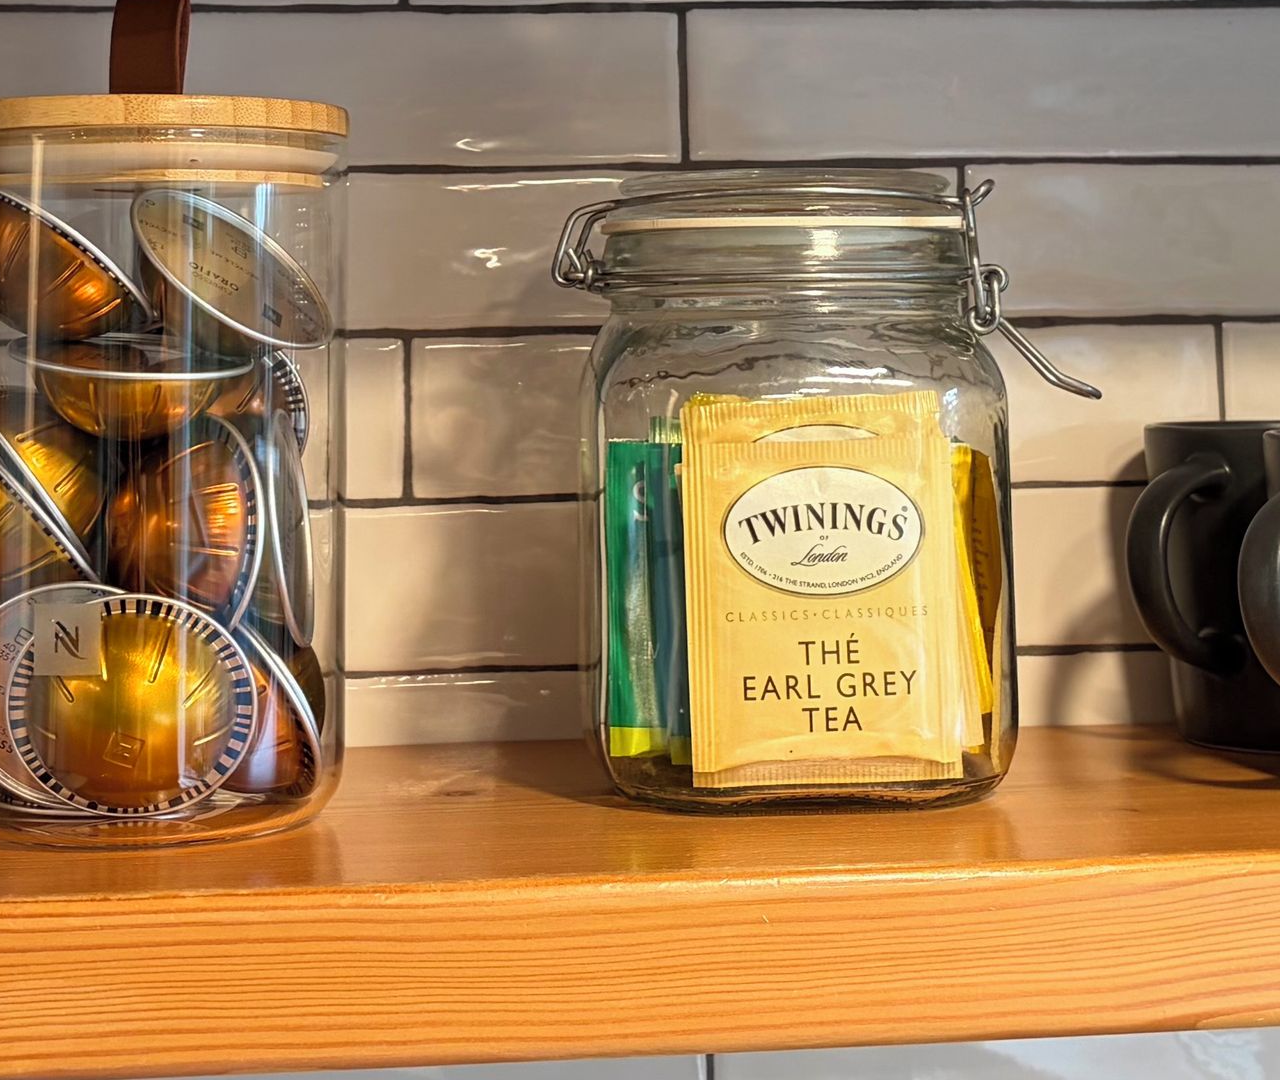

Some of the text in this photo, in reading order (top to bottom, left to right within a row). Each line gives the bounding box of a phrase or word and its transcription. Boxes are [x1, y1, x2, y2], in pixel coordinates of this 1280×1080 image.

[739, 502, 908, 545] TWININGS
[785, 577, 798, 587] THE
[828, 577, 858, 589] LONDON
[875, 553, 903, 577] ENGLAND
[790, 543, 849, 567] London
[725, 605, 929, 623] CLASSICS CLASSIQUES
[798, 632, 861, 666] THÉ
[743, 669, 918, 702] EARL GREY
[801, 705, 863, 733] TEA
